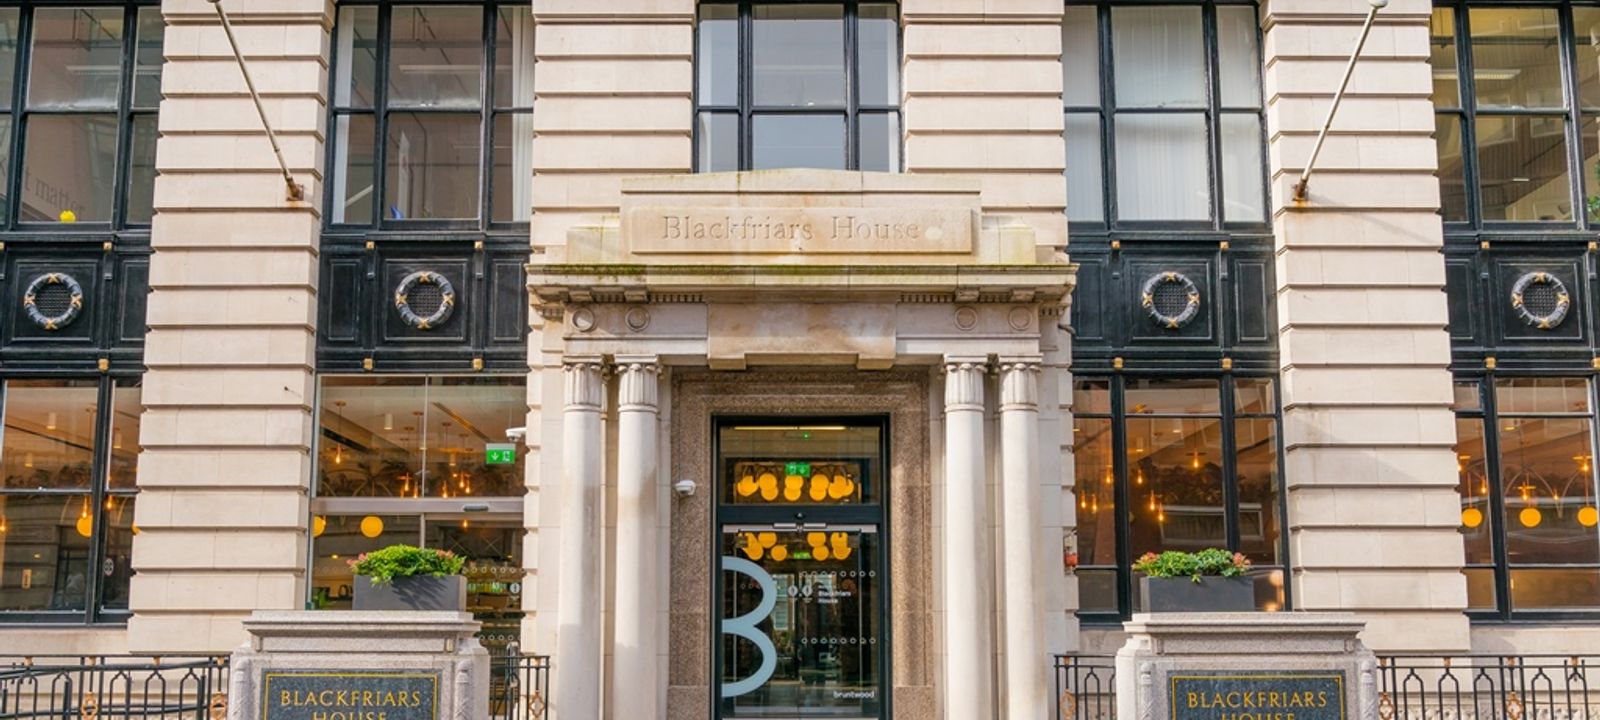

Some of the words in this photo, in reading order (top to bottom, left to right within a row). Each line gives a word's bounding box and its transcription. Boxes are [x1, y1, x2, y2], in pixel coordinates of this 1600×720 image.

[662, 215, 814, 240] Blackfriars
[830, 215, 920, 240] House
[280, 690, 422, 707] BLACKFRIARS
[833, 690, 875, 699] bruntwood
[1187, 691, 1327, 708] BLACKFRIARS
